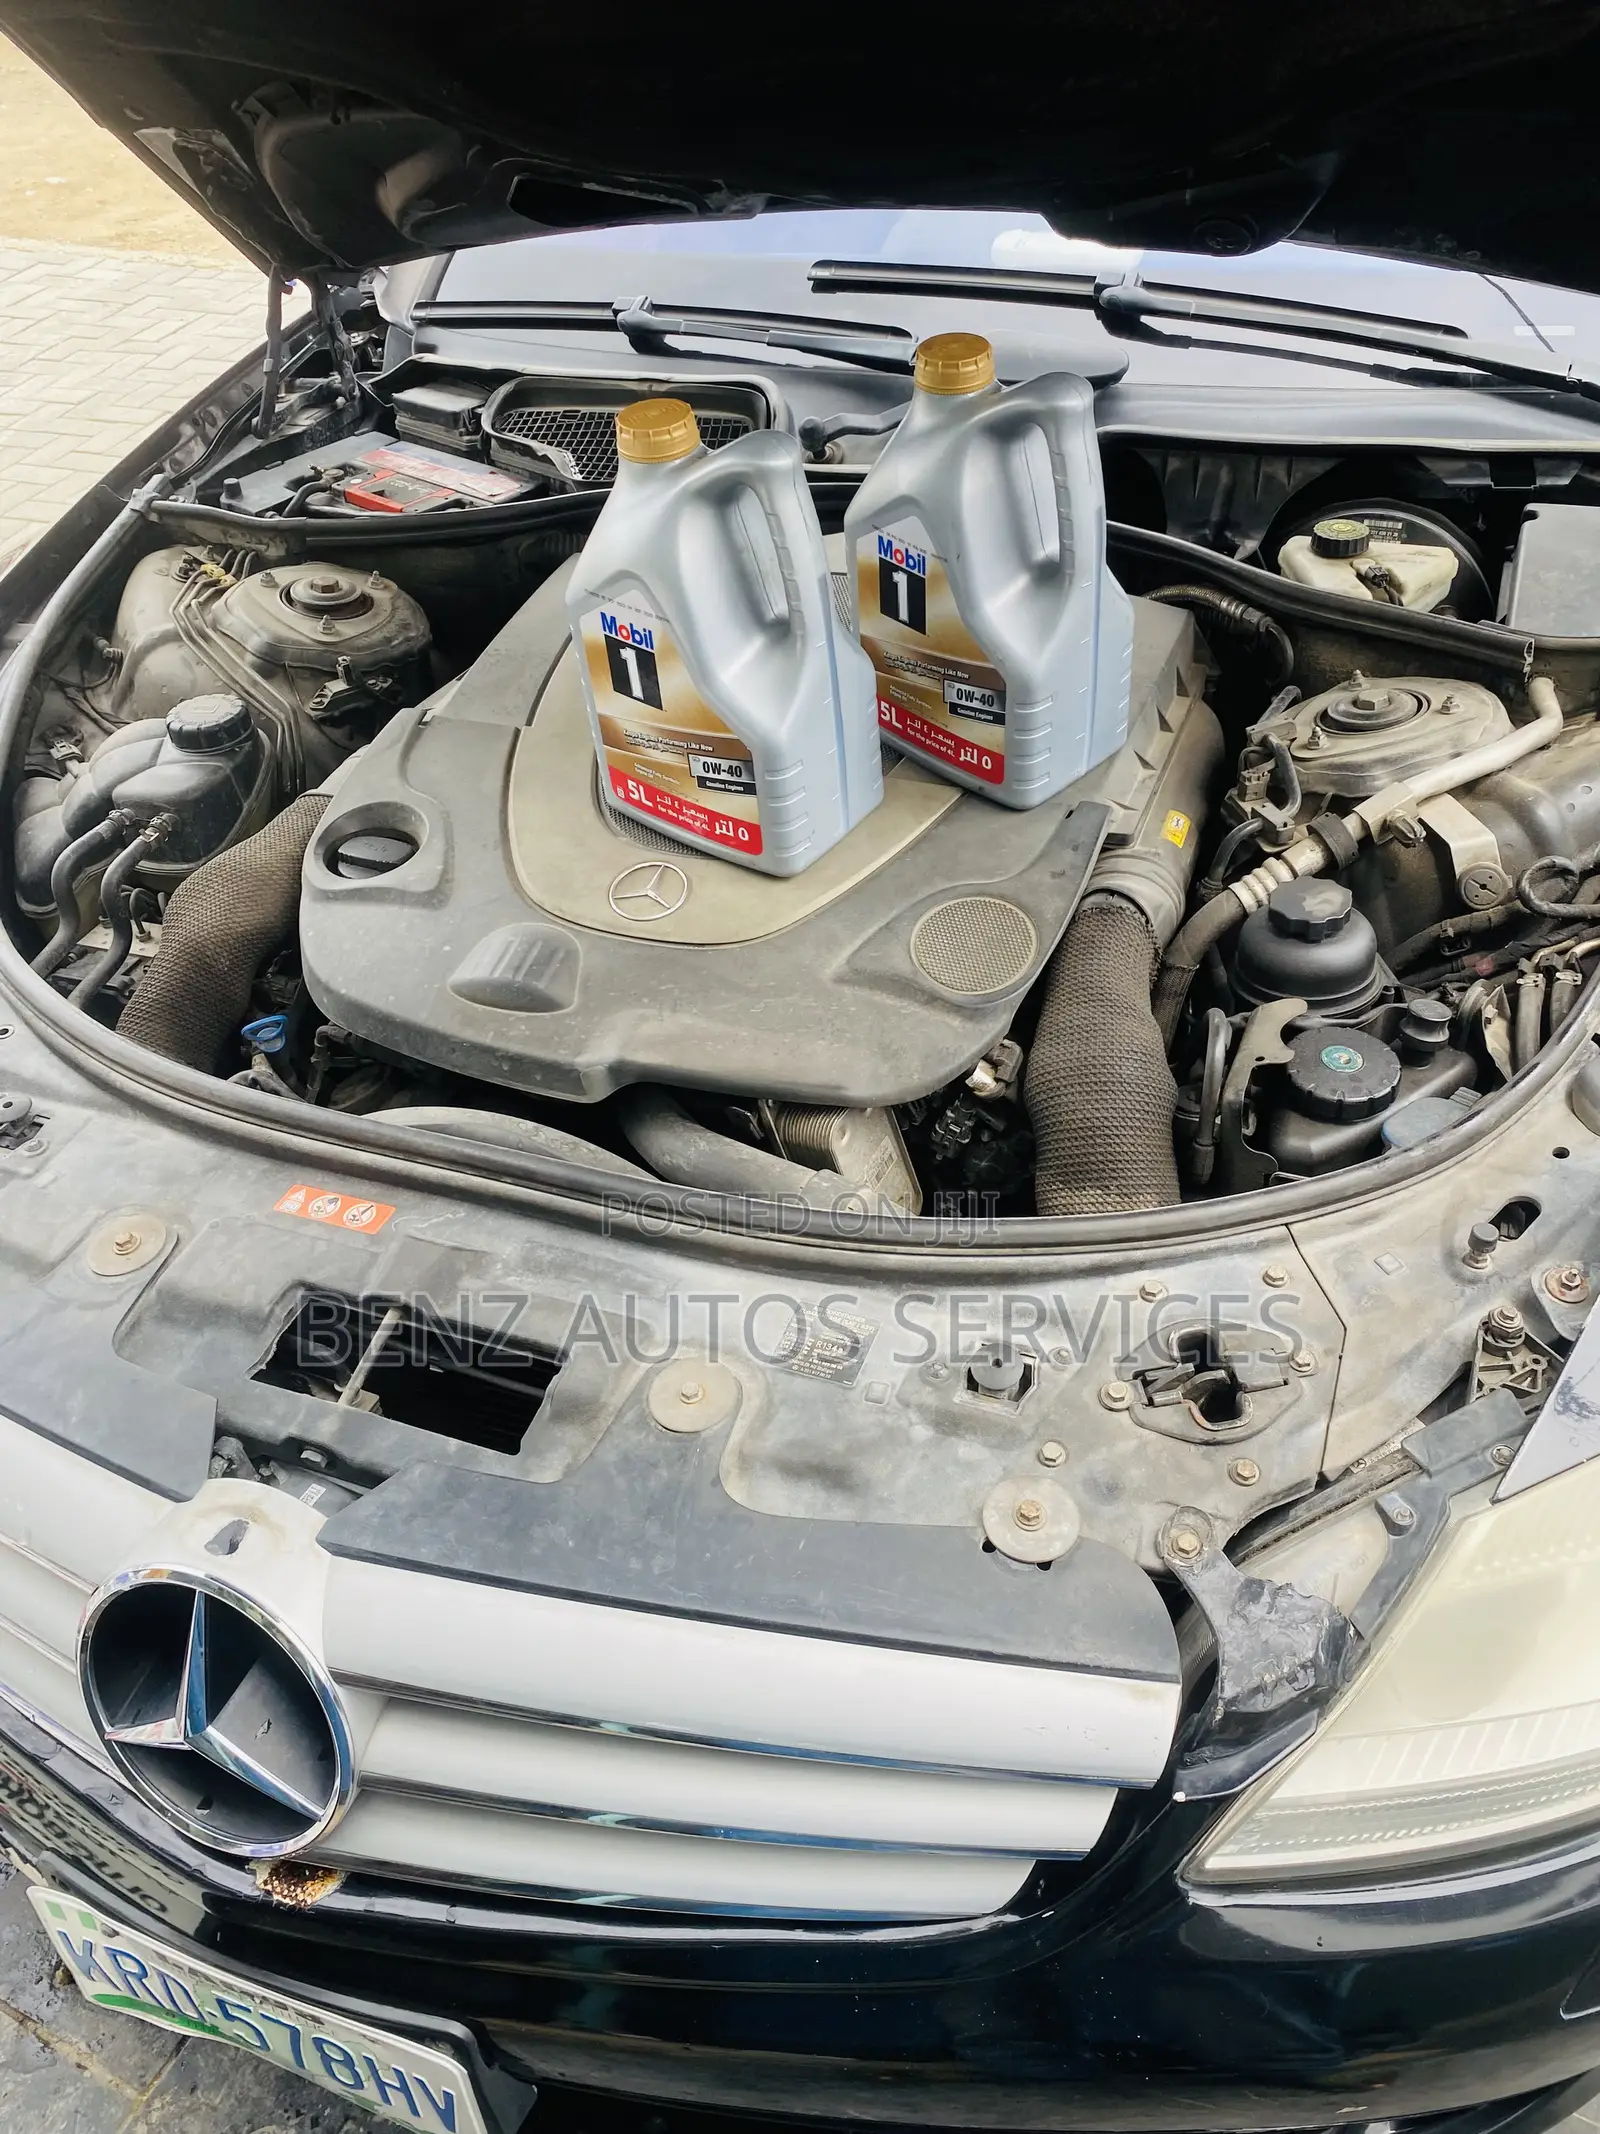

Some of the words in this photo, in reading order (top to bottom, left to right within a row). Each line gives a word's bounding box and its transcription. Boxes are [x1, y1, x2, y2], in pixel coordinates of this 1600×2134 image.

[878, 534, 926, 577] Mobil
[892, 569, 910, 624] 1
[600, 611, 655, 651] Mobil
[619, 646, 645, 701] 1
[917, 660, 944, 674] Performing
[956, 688, 995, 708] 0W-40
[880, 700, 903, 730] 5L
[957, 707, 975, 717] Gasoline
[975, 710, 993, 721] Engines
[659, 736, 688, 749] Performing
[907, 727, 915, 737] for
[916, 732, 926, 742] the
[926, 737, 940, 750] price
[940, 744, 947, 753] of
[947, 748, 956, 758] 4L
[959, 746, 978, 765] لتر
[702, 761, 743, 778] 0W-40
[627, 779, 654, 808] 5L
[706, 780, 725, 790] Gasoline
[725, 782, 744, 792] Engines
[658, 804, 667, 813] for
[667, 807, 677, 818] the
[679, 812, 693, 825] price
[694, 819, 701, 827] of
[702, 822, 711, 831] 4L
[715, 819, 734, 837] لتر
[815, 1340, 844, 1353] R134a
[57, 1930, 458, 2133] KRD-578HV
